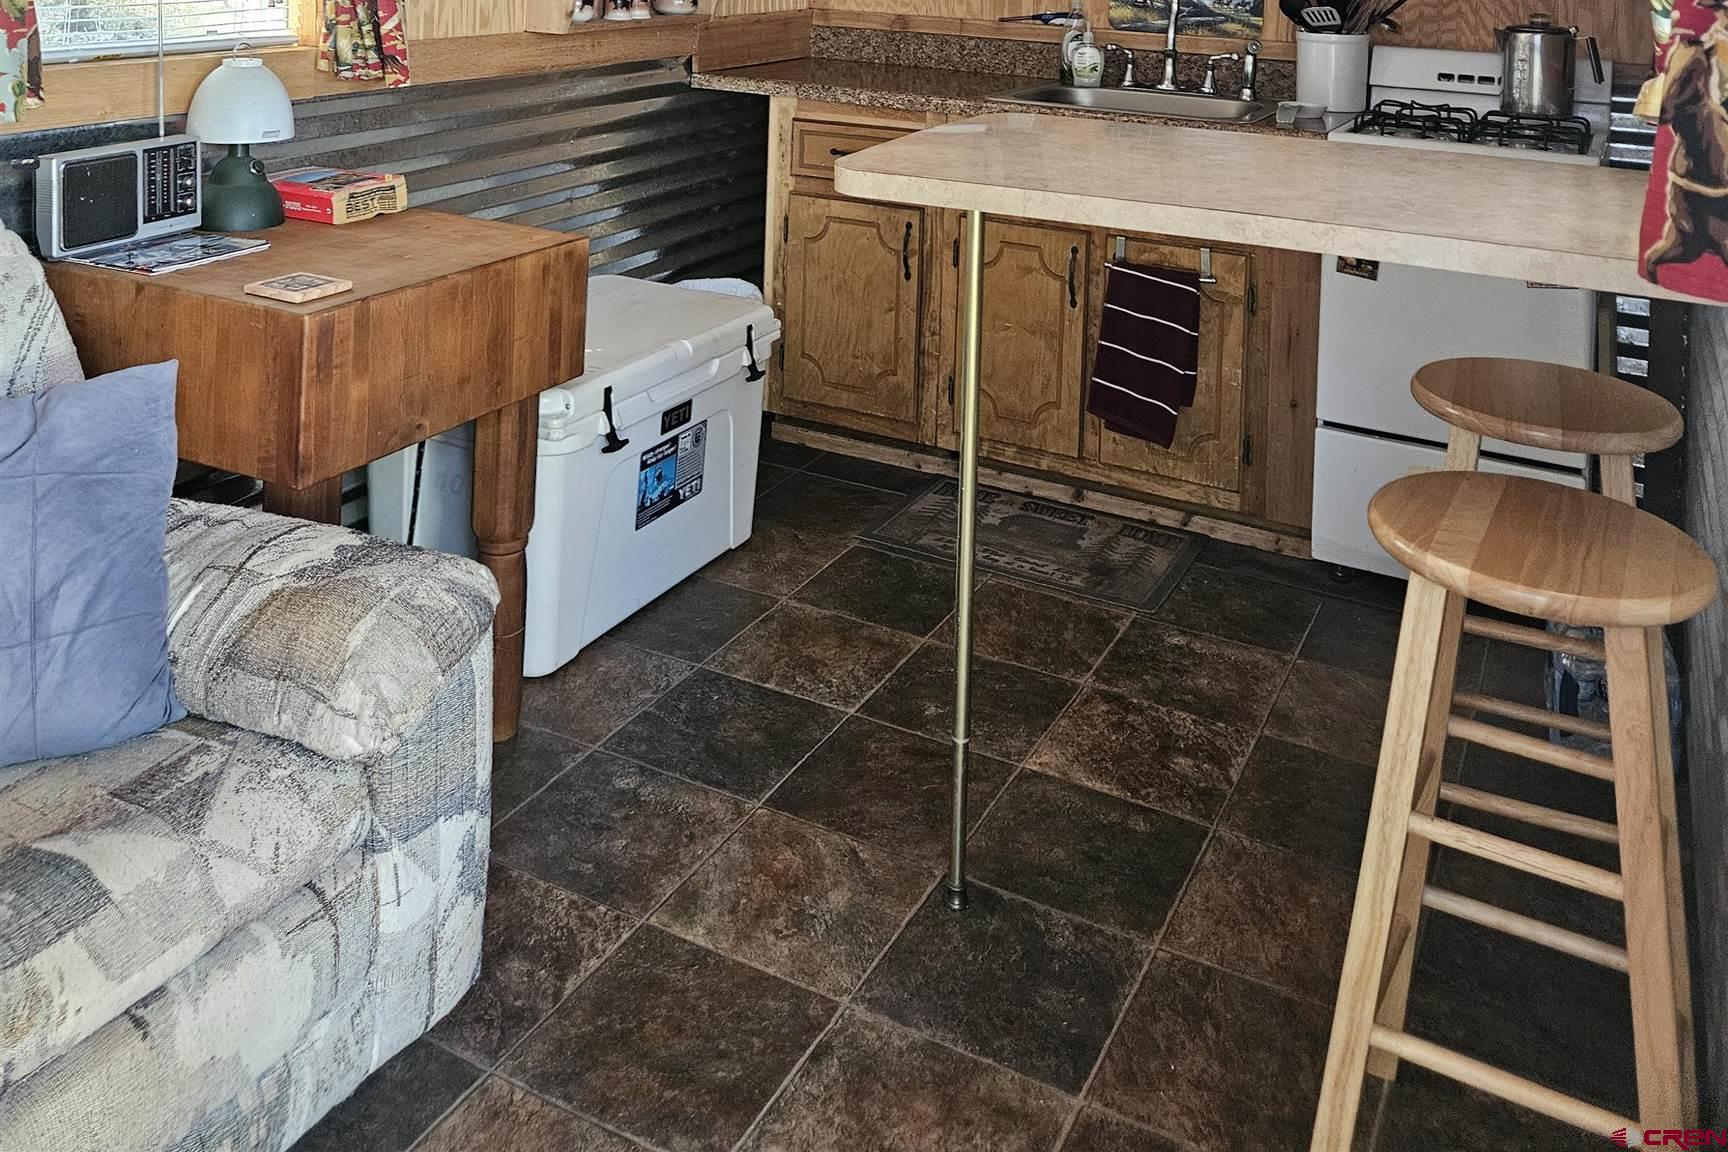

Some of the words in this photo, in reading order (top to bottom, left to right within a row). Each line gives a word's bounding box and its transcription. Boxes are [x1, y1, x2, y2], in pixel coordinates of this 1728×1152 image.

[346, 197, 377, 213] BEST
[664, 406, 690, 429] YETI
[679, 478, 701, 500] YETI
